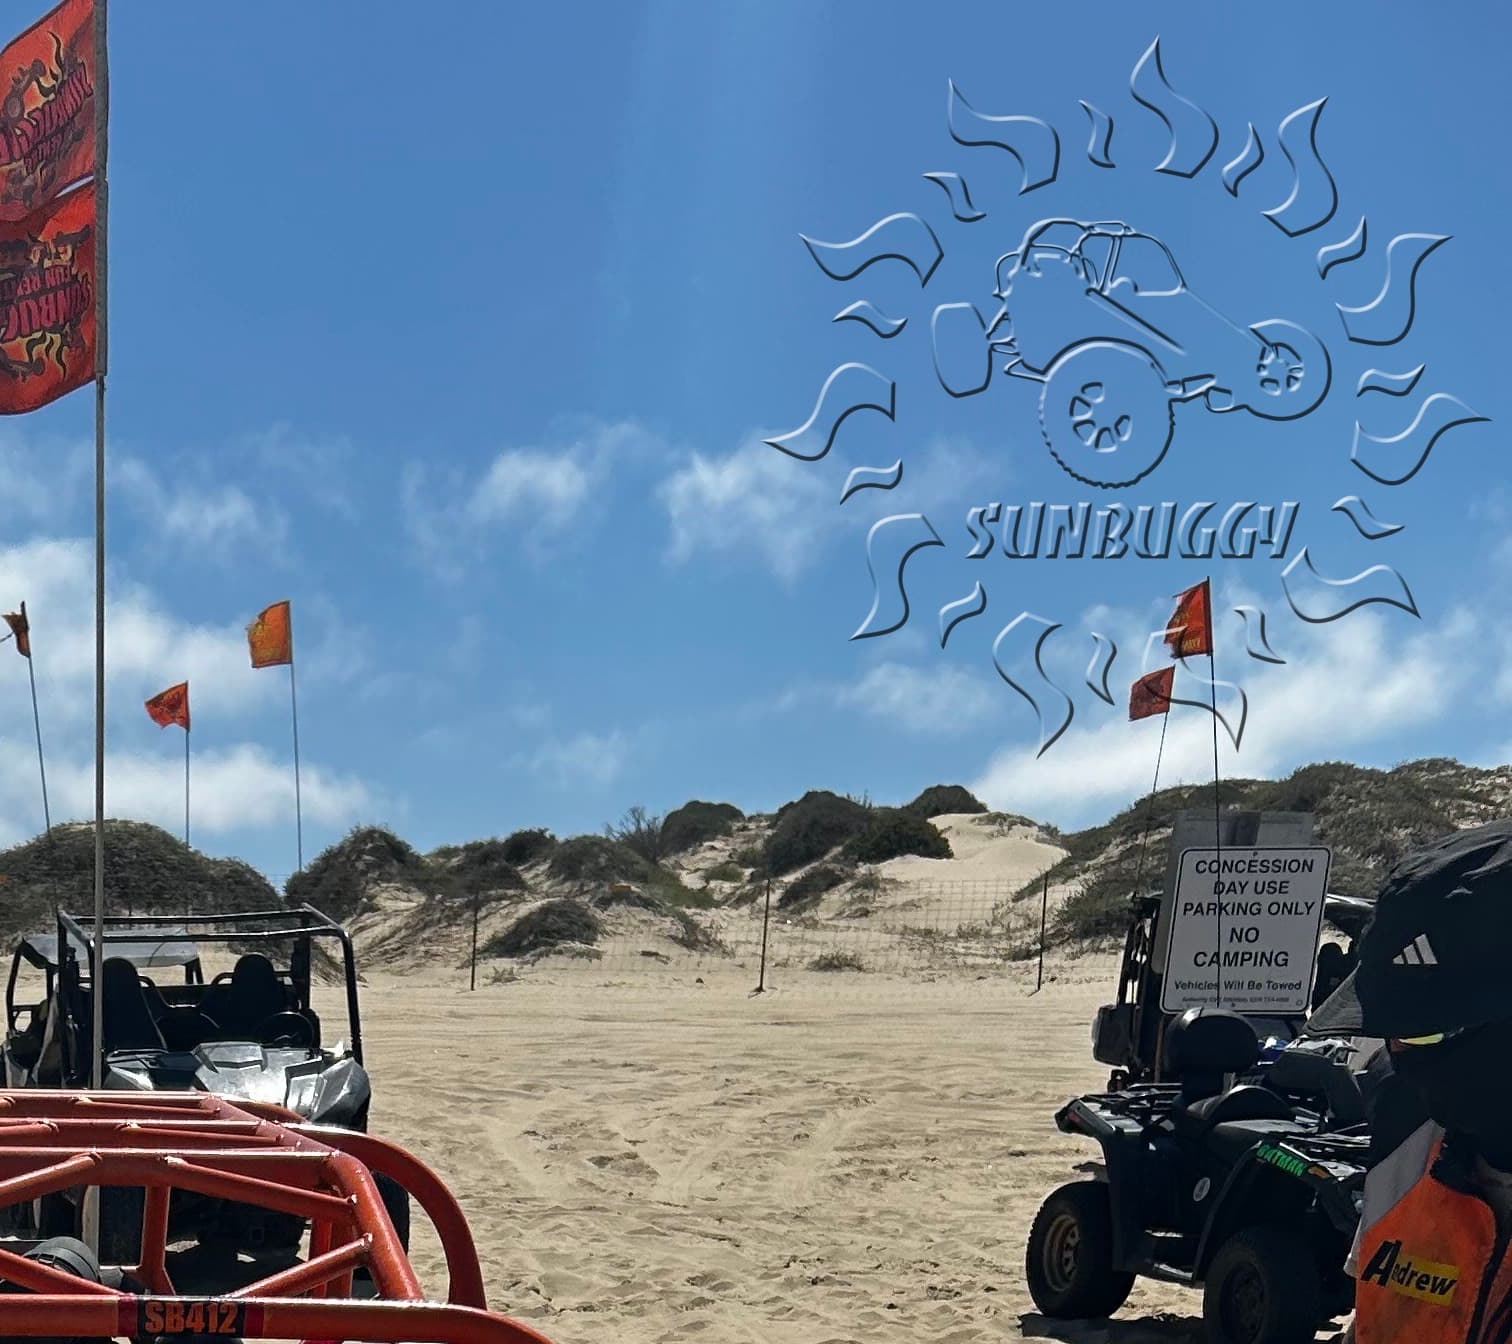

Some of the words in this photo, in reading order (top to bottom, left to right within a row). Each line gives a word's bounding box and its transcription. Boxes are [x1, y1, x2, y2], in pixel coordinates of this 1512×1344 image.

[1195, 858, 1314, 875] CONCESSION
[1214, 880, 1249, 896] DAY
[1254, 880, 1290, 895] USE
[1183, 901, 1262, 917] PARKING
[1268, 901, 1316, 916] ONLY
[1229, 926, 1260, 944] NO
[1193, 950, 1290, 968] CAMPING
[1174, 979, 1219, 991] Vehicles
[1224, 980, 1244, 991] Will
[1247, 980, 1263, 991] Be
[1266, 980, 1302, 991] Towed
[144, 1301, 238, 1335] SB412
